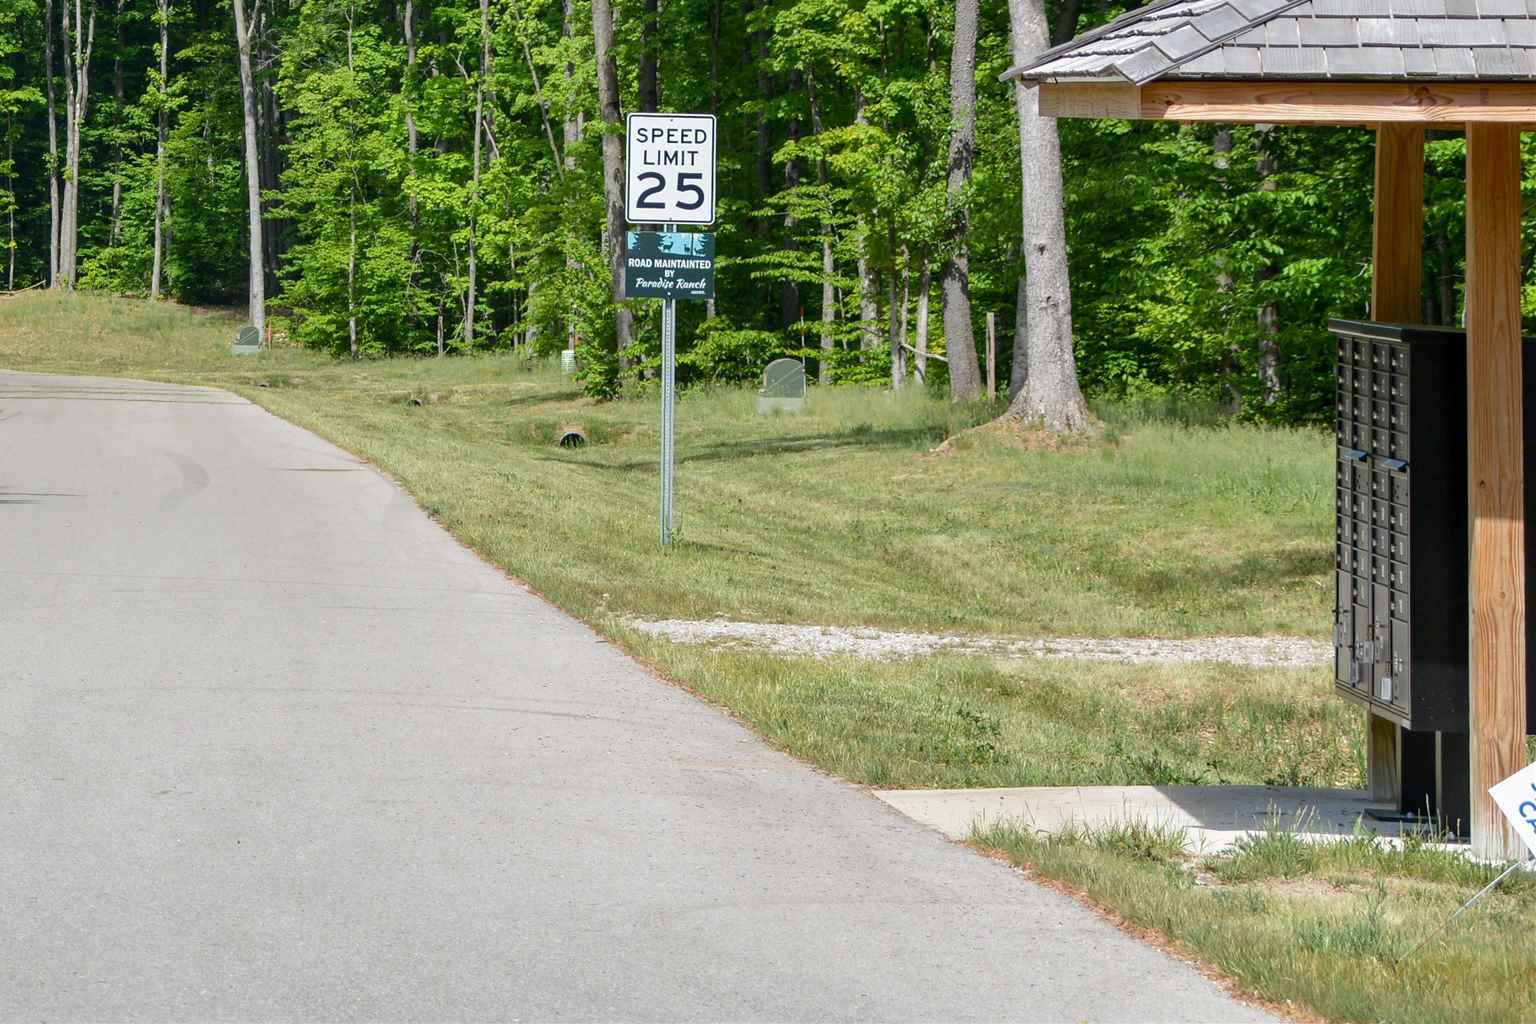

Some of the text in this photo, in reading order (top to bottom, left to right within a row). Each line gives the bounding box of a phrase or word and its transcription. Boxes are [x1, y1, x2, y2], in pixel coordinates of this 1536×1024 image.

[636, 127, 707, 144] SPEED
[643, 150, 699, 166] LIMIT
[636, 171, 705, 211] 25
[628, 258, 711, 269] ROAD MAINTAINTED
[664, 269, 675, 278] BY
[635, 277, 706, 289] Paradise Ranch
